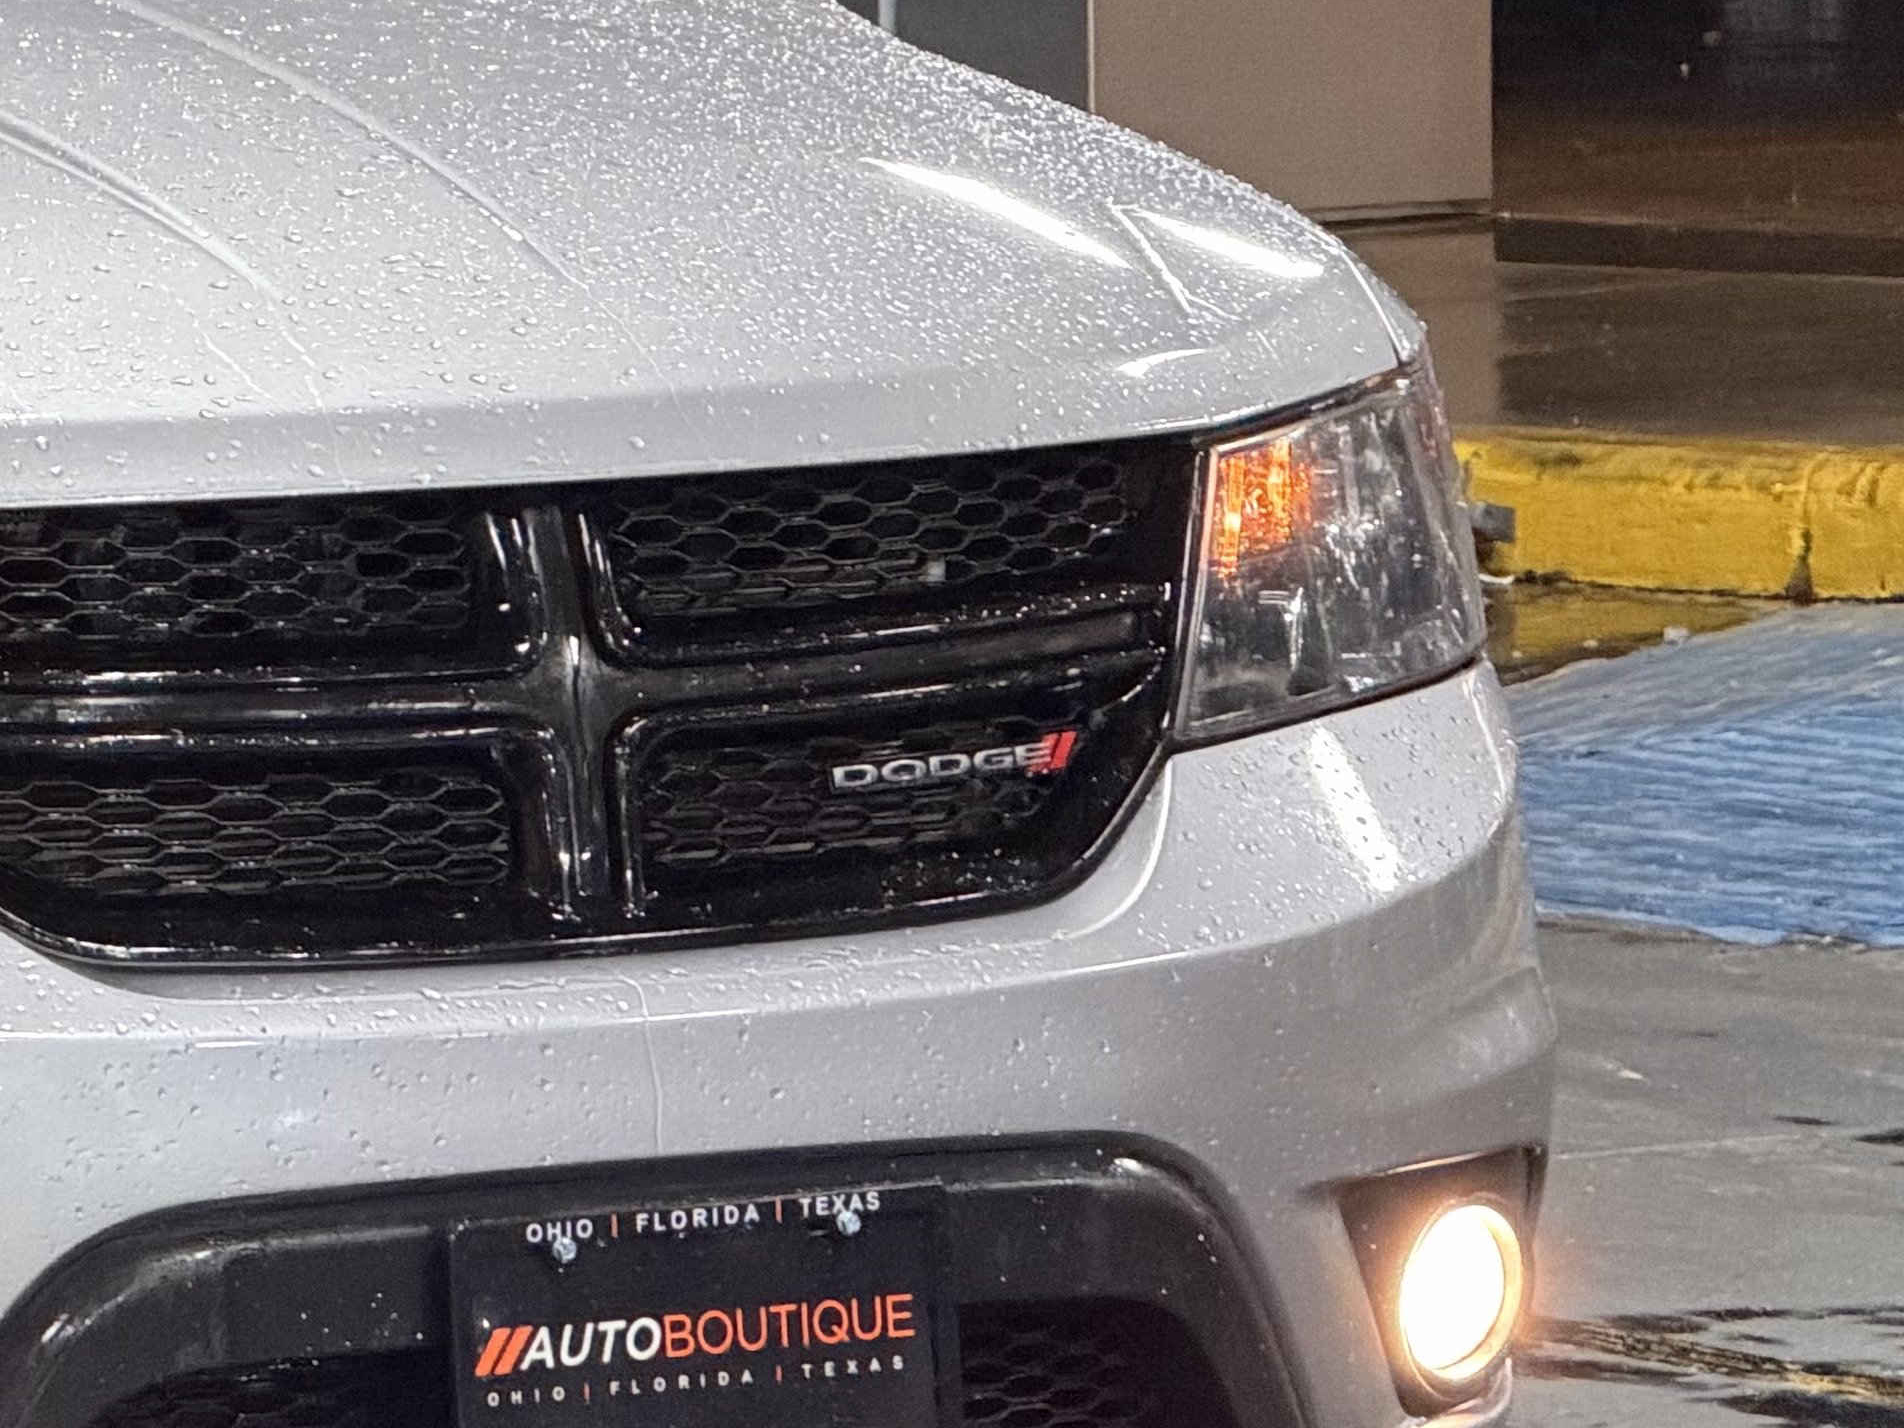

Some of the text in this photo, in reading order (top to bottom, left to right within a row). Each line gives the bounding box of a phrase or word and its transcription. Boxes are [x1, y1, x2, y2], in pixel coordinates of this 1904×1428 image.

[832, 742, 1052, 788] DODGE
[526, 1191, 881, 1243] OHIO FLORIDA TEXAS
[520, 1293, 915, 1370] AUTOBOUTIQUE
[487, 1356, 905, 1407] OHIO FLORIDA TEXAS
